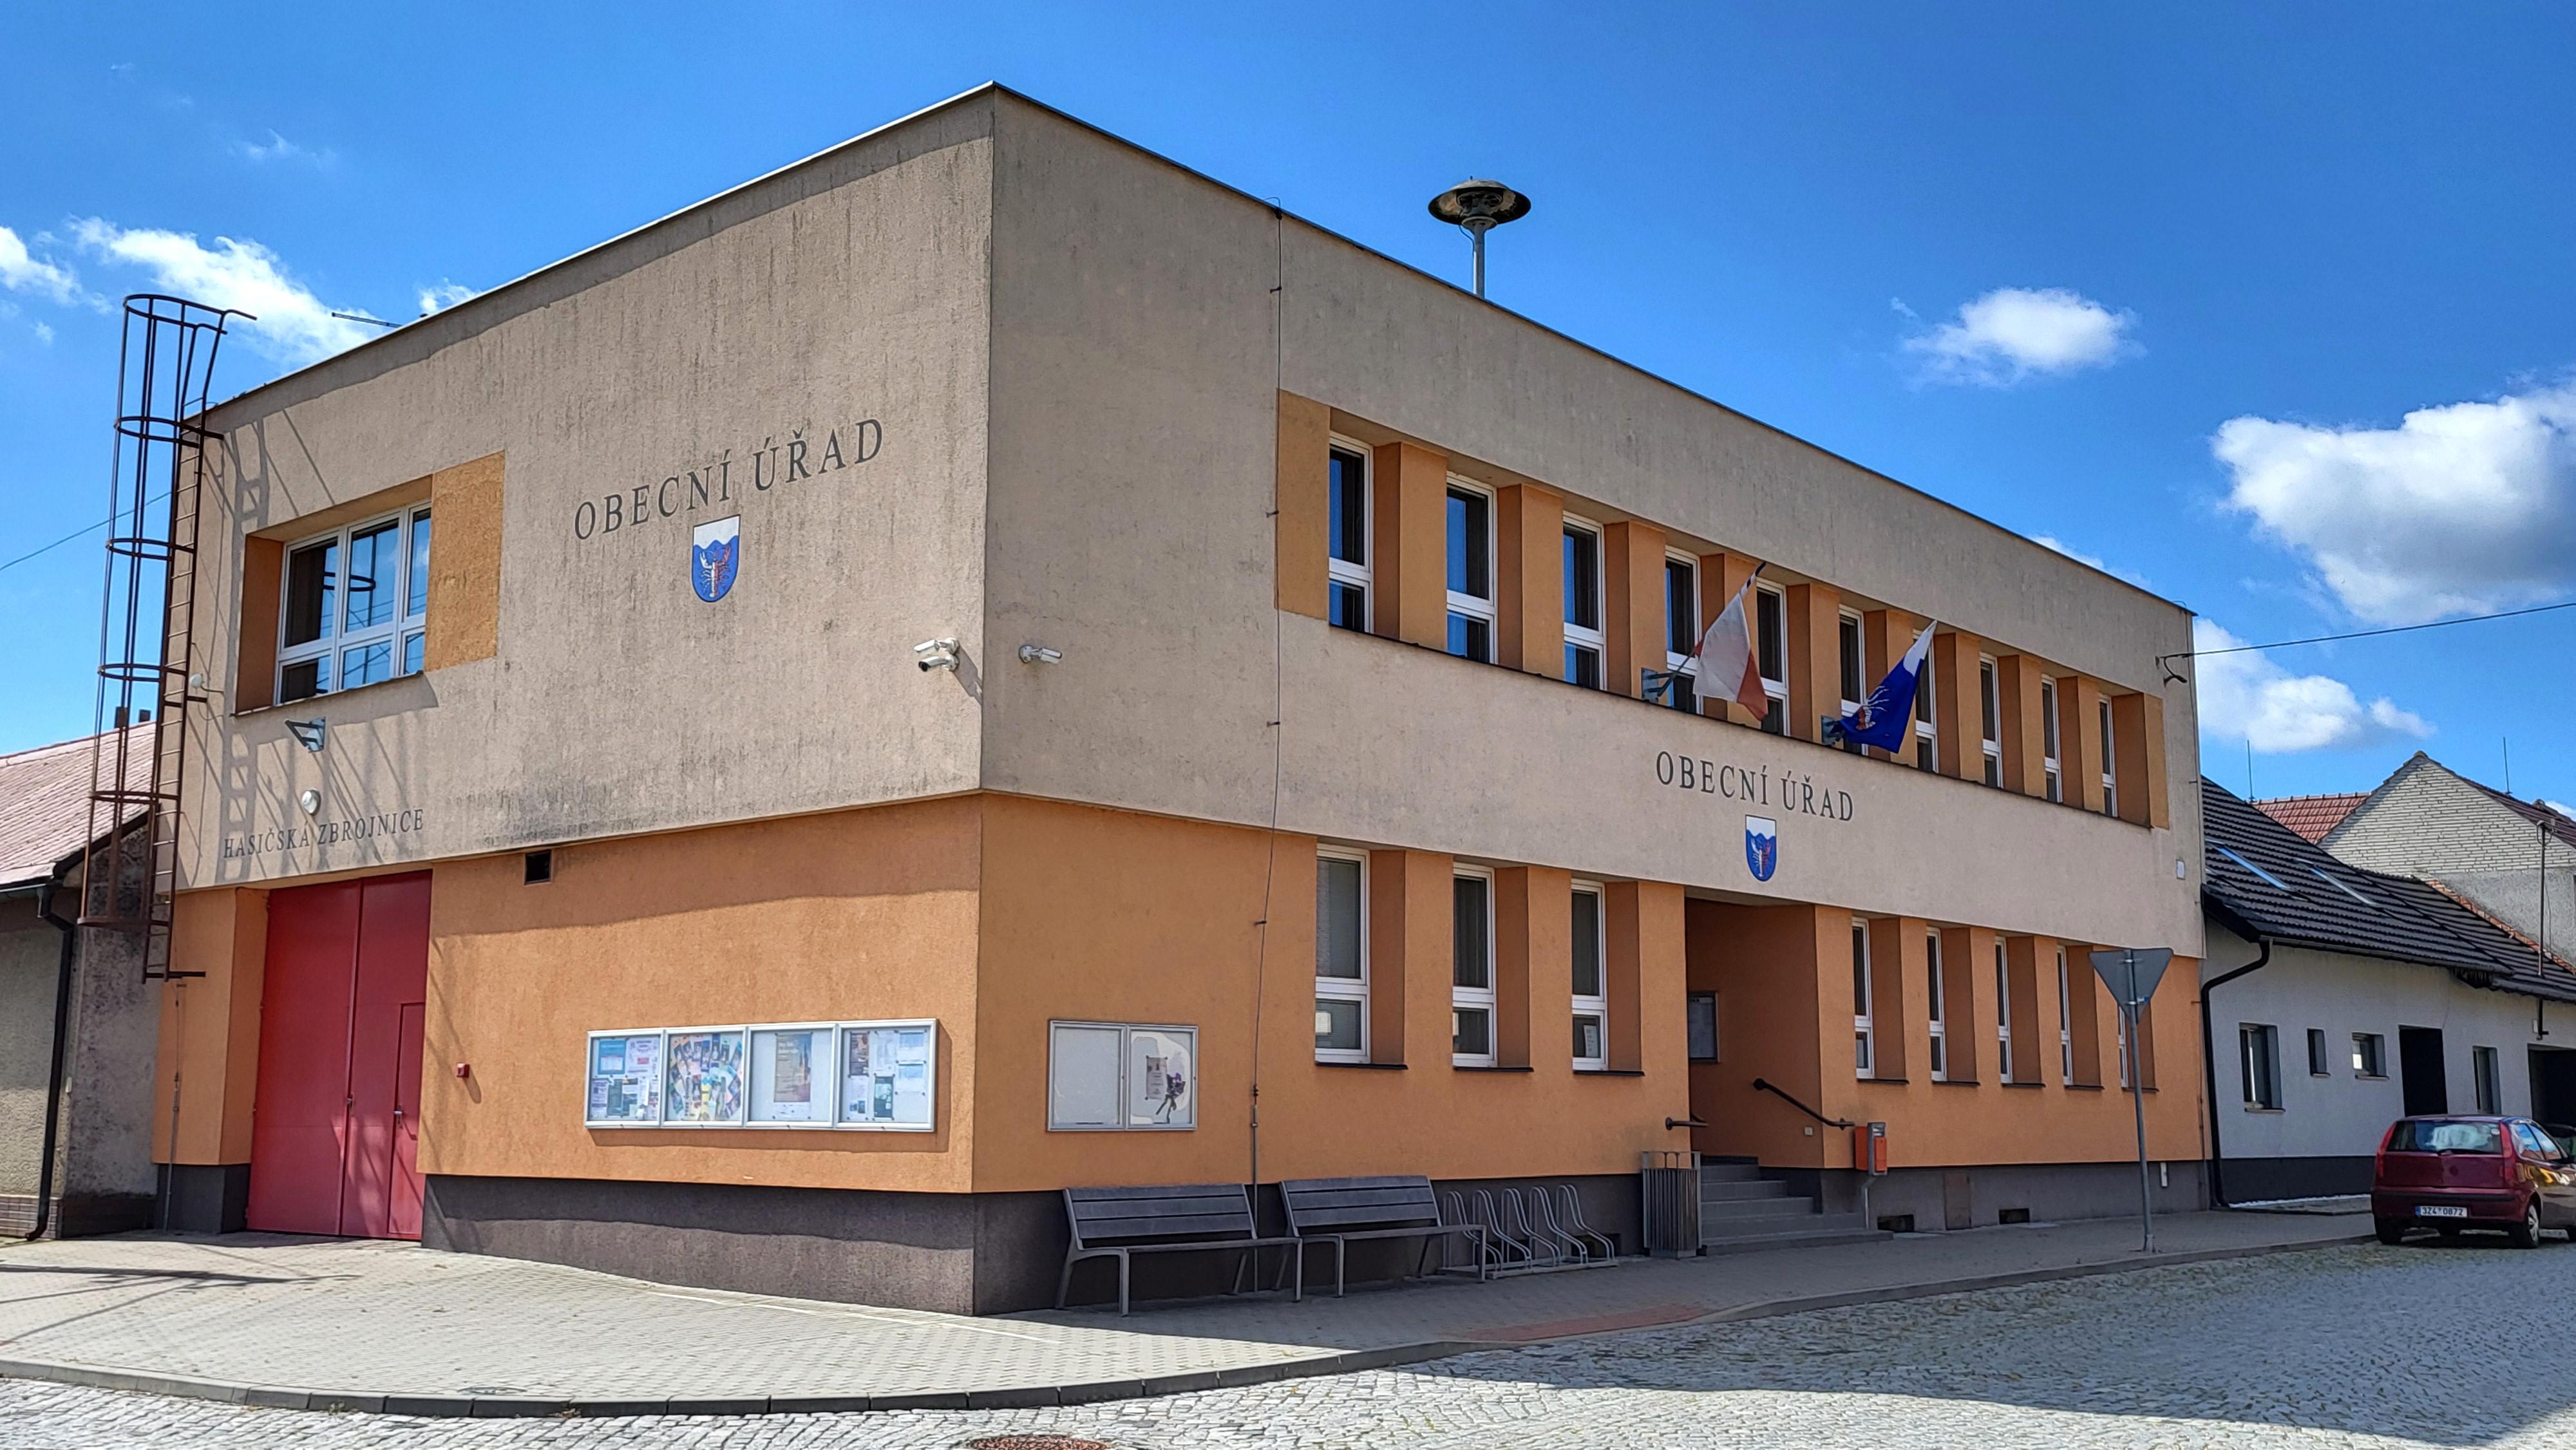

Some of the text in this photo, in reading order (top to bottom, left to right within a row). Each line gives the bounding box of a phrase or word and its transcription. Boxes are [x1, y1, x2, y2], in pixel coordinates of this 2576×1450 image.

[574, 419, 883, 540] OBECNÍ ÚŘAD
[1656, 750, 1853, 822] OBECNÍ ÚŘAD
[223, 808, 425, 858] HASIČSKÁ ZBROJNICE
